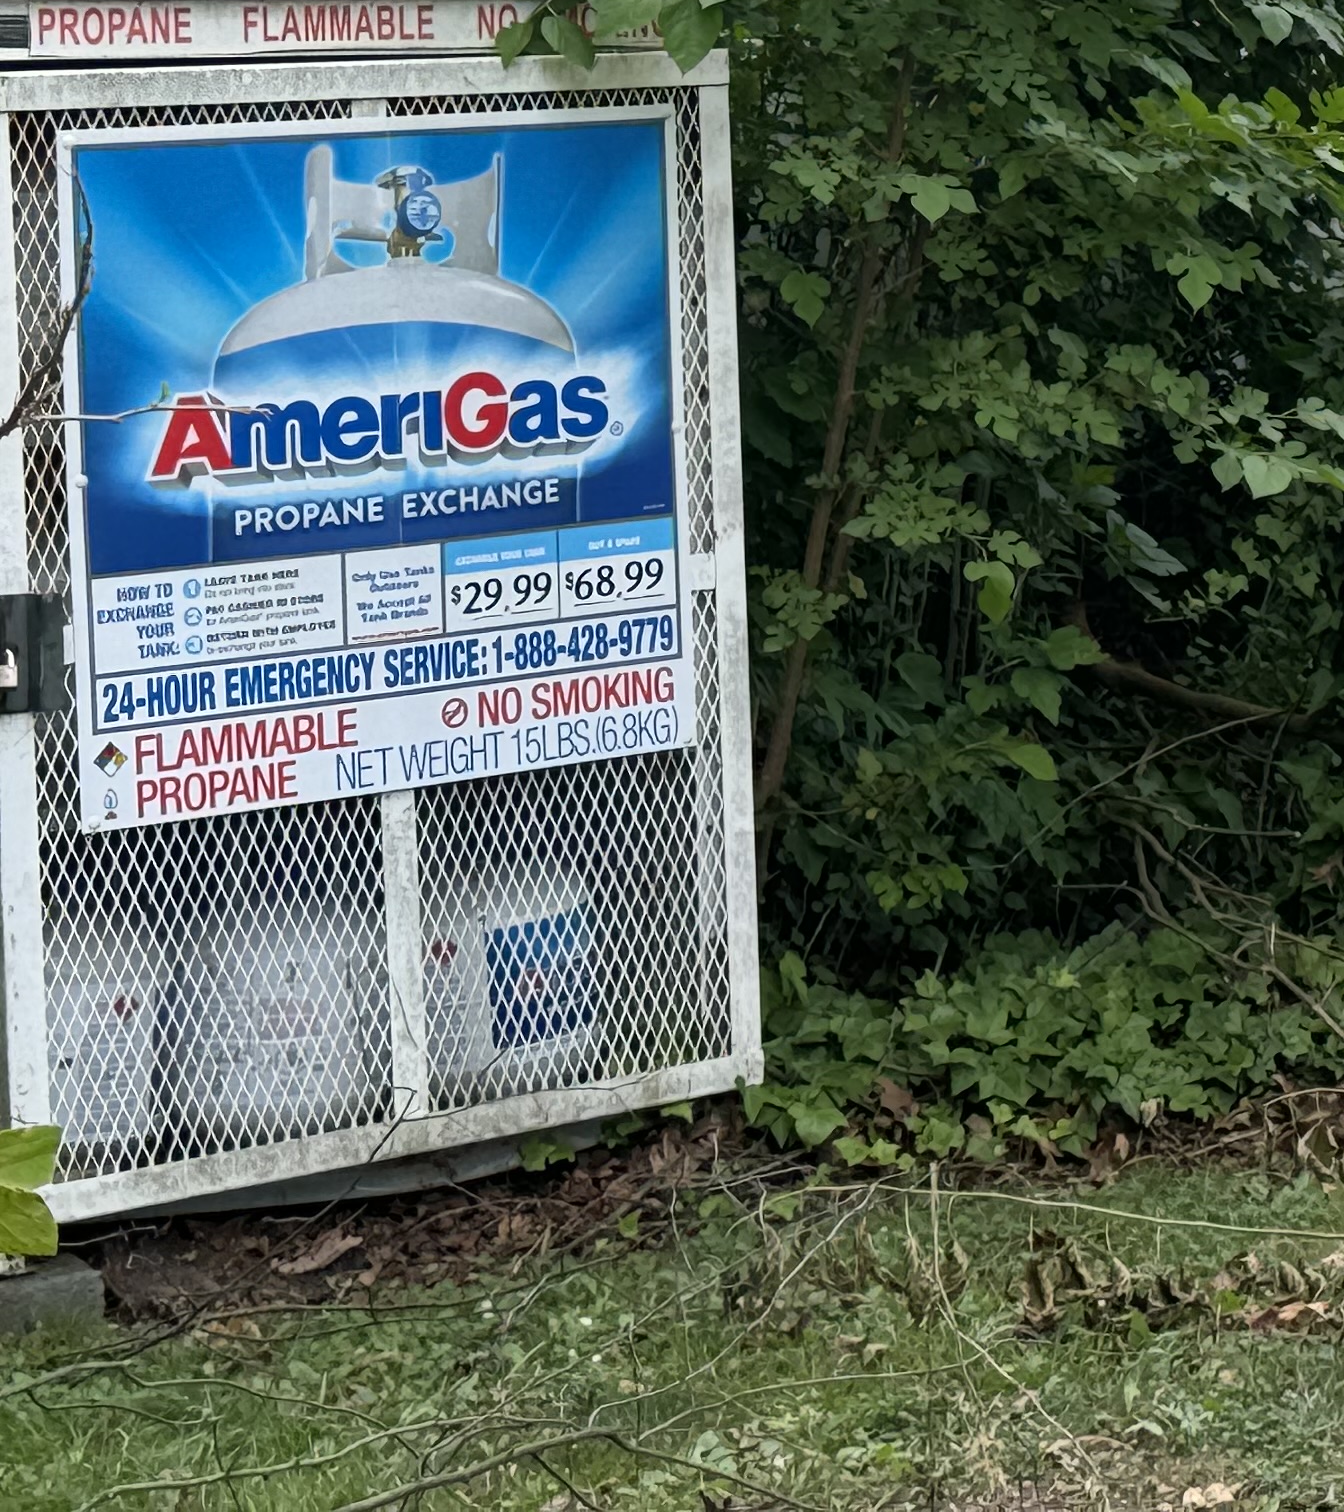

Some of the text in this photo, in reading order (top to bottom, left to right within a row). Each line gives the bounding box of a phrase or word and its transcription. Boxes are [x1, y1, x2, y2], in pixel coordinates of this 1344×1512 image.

[37, 6, 193, 46] PROPANE
[242, 4, 435, 44] FLAMMABLE
[477, 3, 519, 40] NO
[150, 370, 611, 478] AmeriGas
[234, 478, 561, 537] PROPANE EXCHANGE
[451, 571, 553, 615] $29.99
[565, 557, 664, 602] $68.99
[136, 621, 175, 640] YOUR
[102, 614, 674, 723] 24-HOUR EMERGENCY SERVICE: 1-888-428-9779
[477, 666, 676, 728] NO SMOKING
[134, 708, 359, 775] FLAMMABLE
[336, 746, 394, 791] NET
[399, 731, 505, 781] WEIGHT
[136, 760, 299, 819] PROPANE
